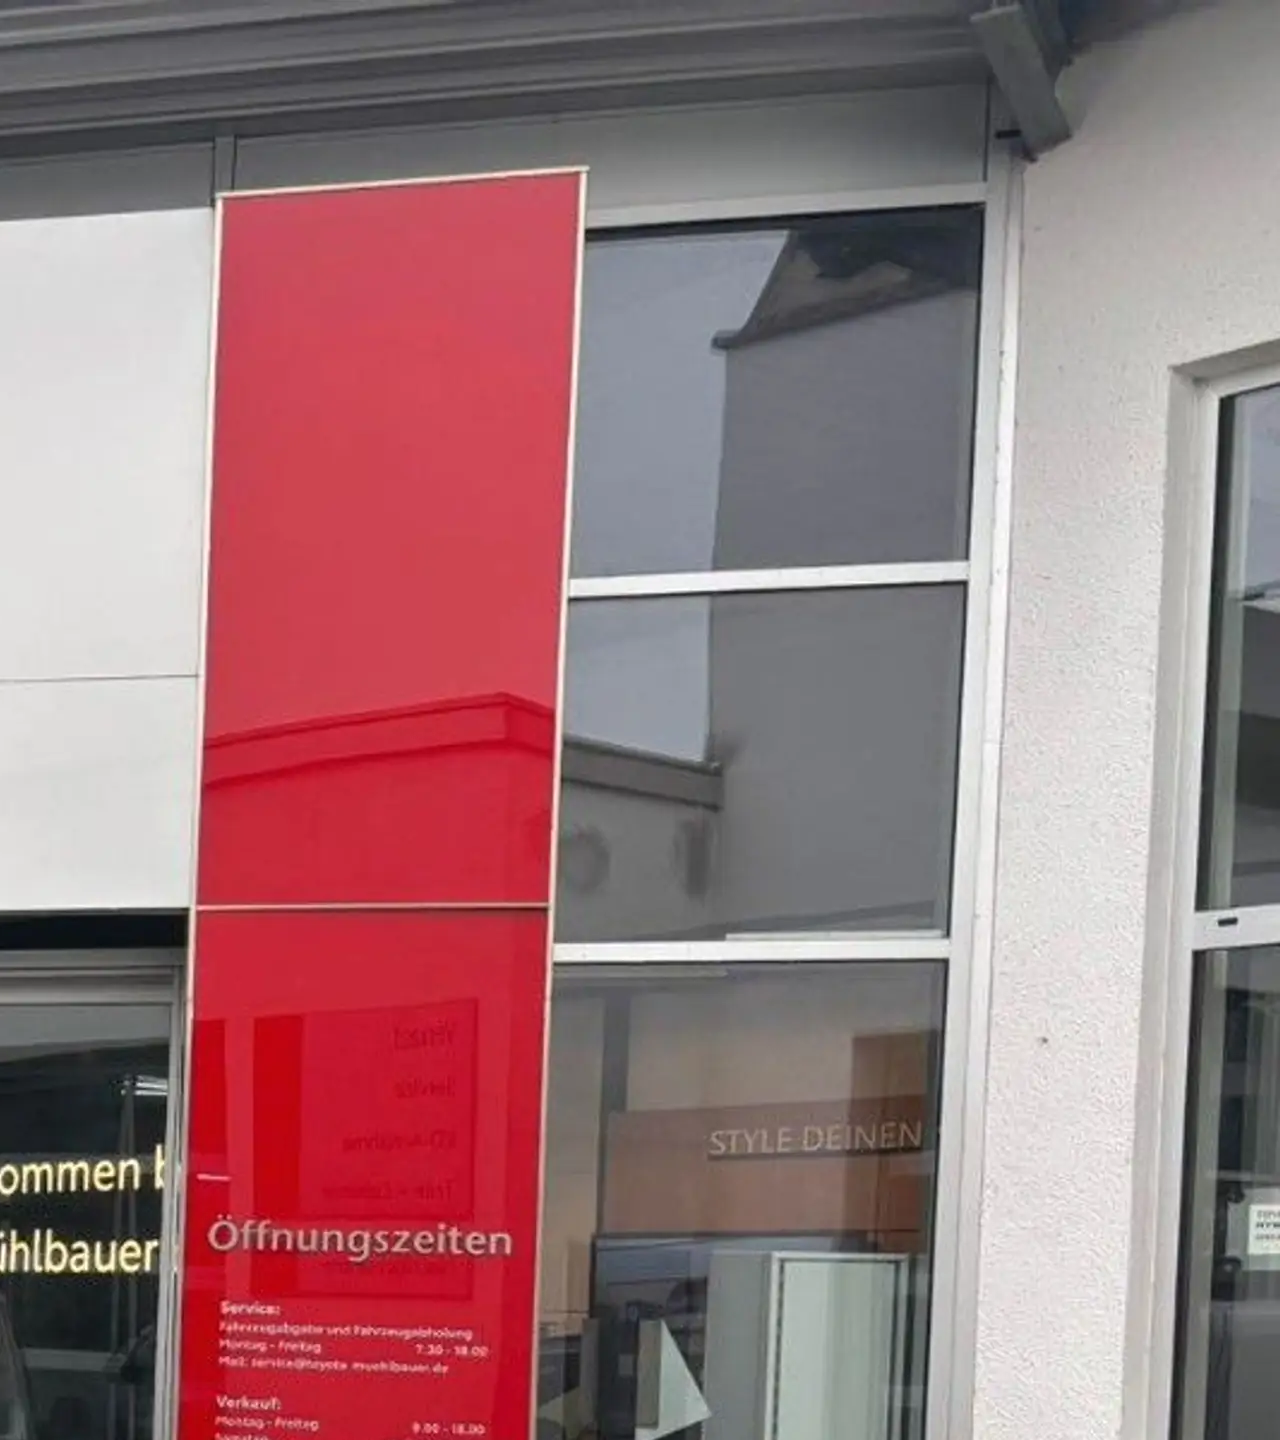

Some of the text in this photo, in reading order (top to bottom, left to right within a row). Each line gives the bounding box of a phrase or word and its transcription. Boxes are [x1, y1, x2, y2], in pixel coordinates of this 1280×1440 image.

[708, 1120, 923, 1155] STYLE DEINEN
[207, 1214, 513, 1263] Öffnungszeiten
[220, 1301, 281, 1316] Service:
[219, 1338, 266, 1355] Montag
[278, 1340, 322, 1355] Freitag
[216, 1395, 282, 1411] Verkauf:
[214, 1415, 264, 1431] Montag
[273, 1417, 319, 1431] Freitag
